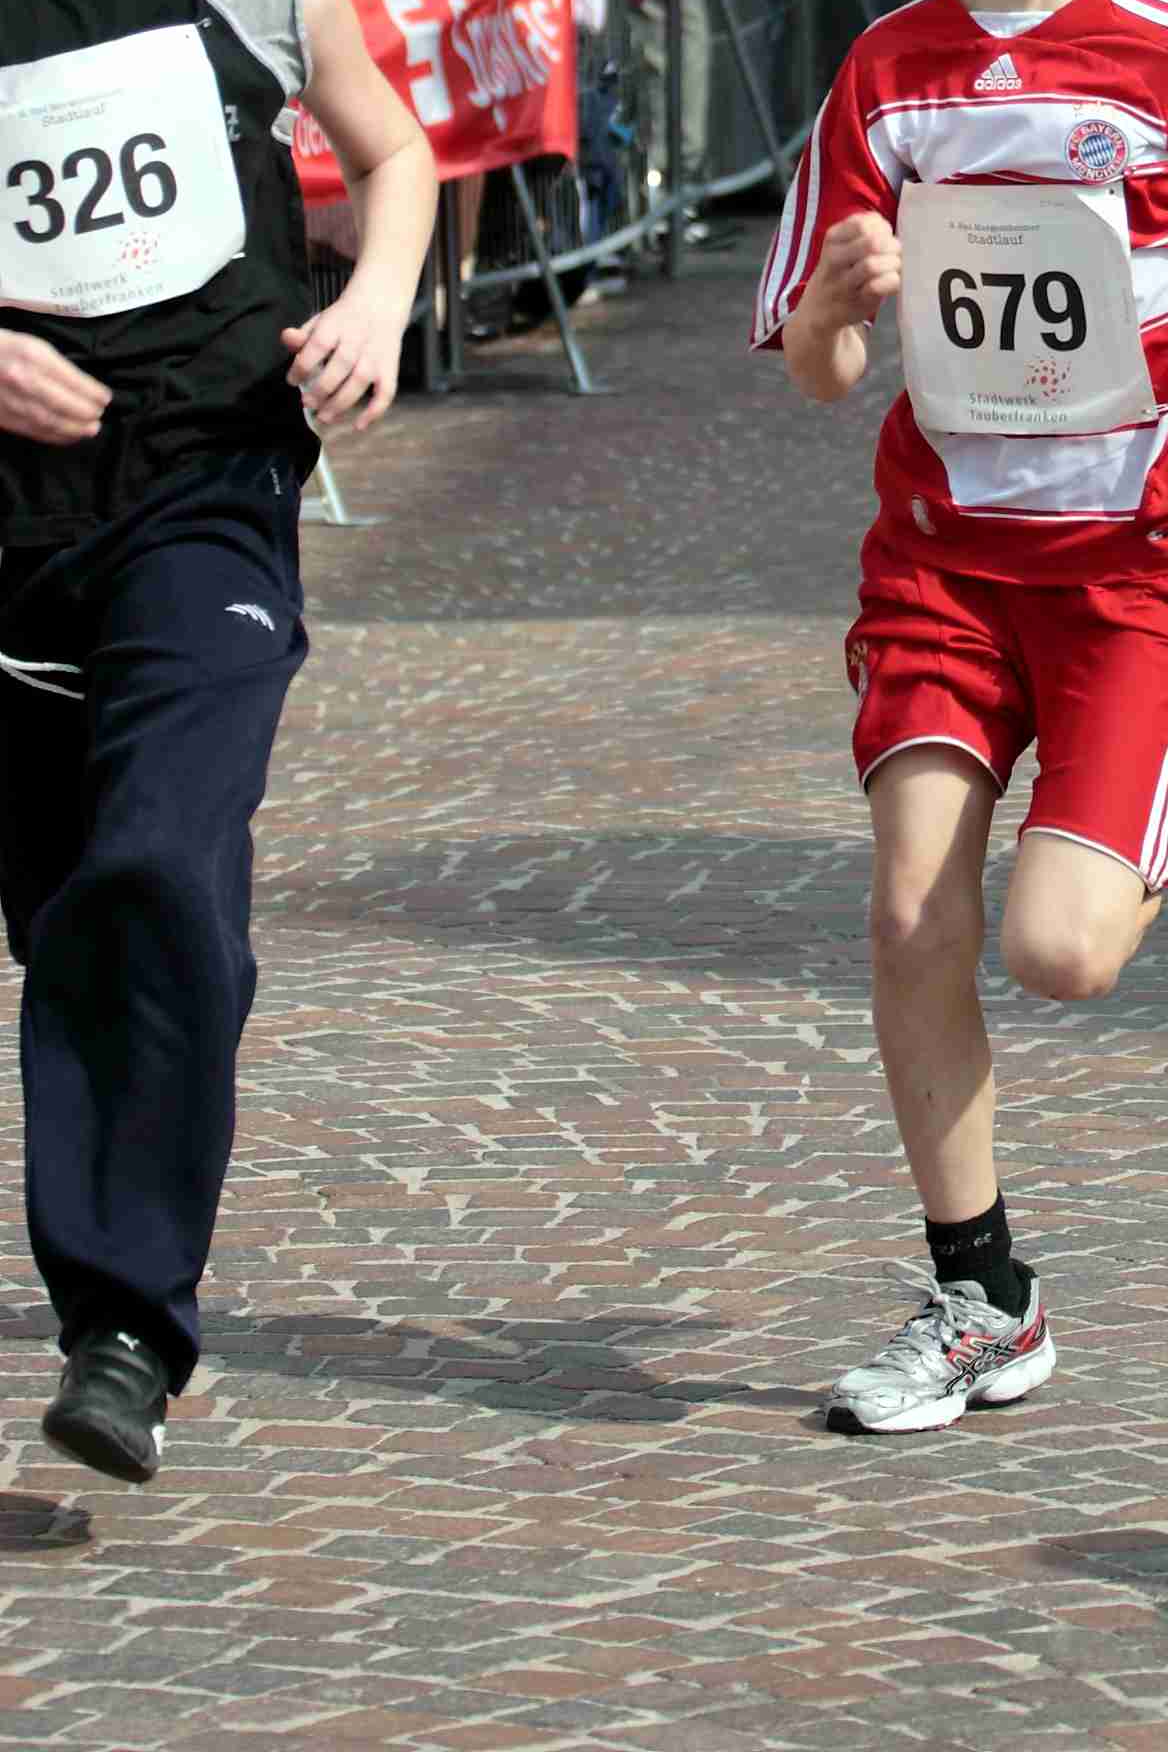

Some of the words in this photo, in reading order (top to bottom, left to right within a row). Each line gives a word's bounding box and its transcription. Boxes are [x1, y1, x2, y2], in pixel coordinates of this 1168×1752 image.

[974, 74, 1023, 90] adidas
[6, 131, 178, 245] 326
[967, 233, 1025, 246] Stadtlauf
[937, 267, 1088, 352] 679
[968, 391, 1039, 406] Stadtwerk
